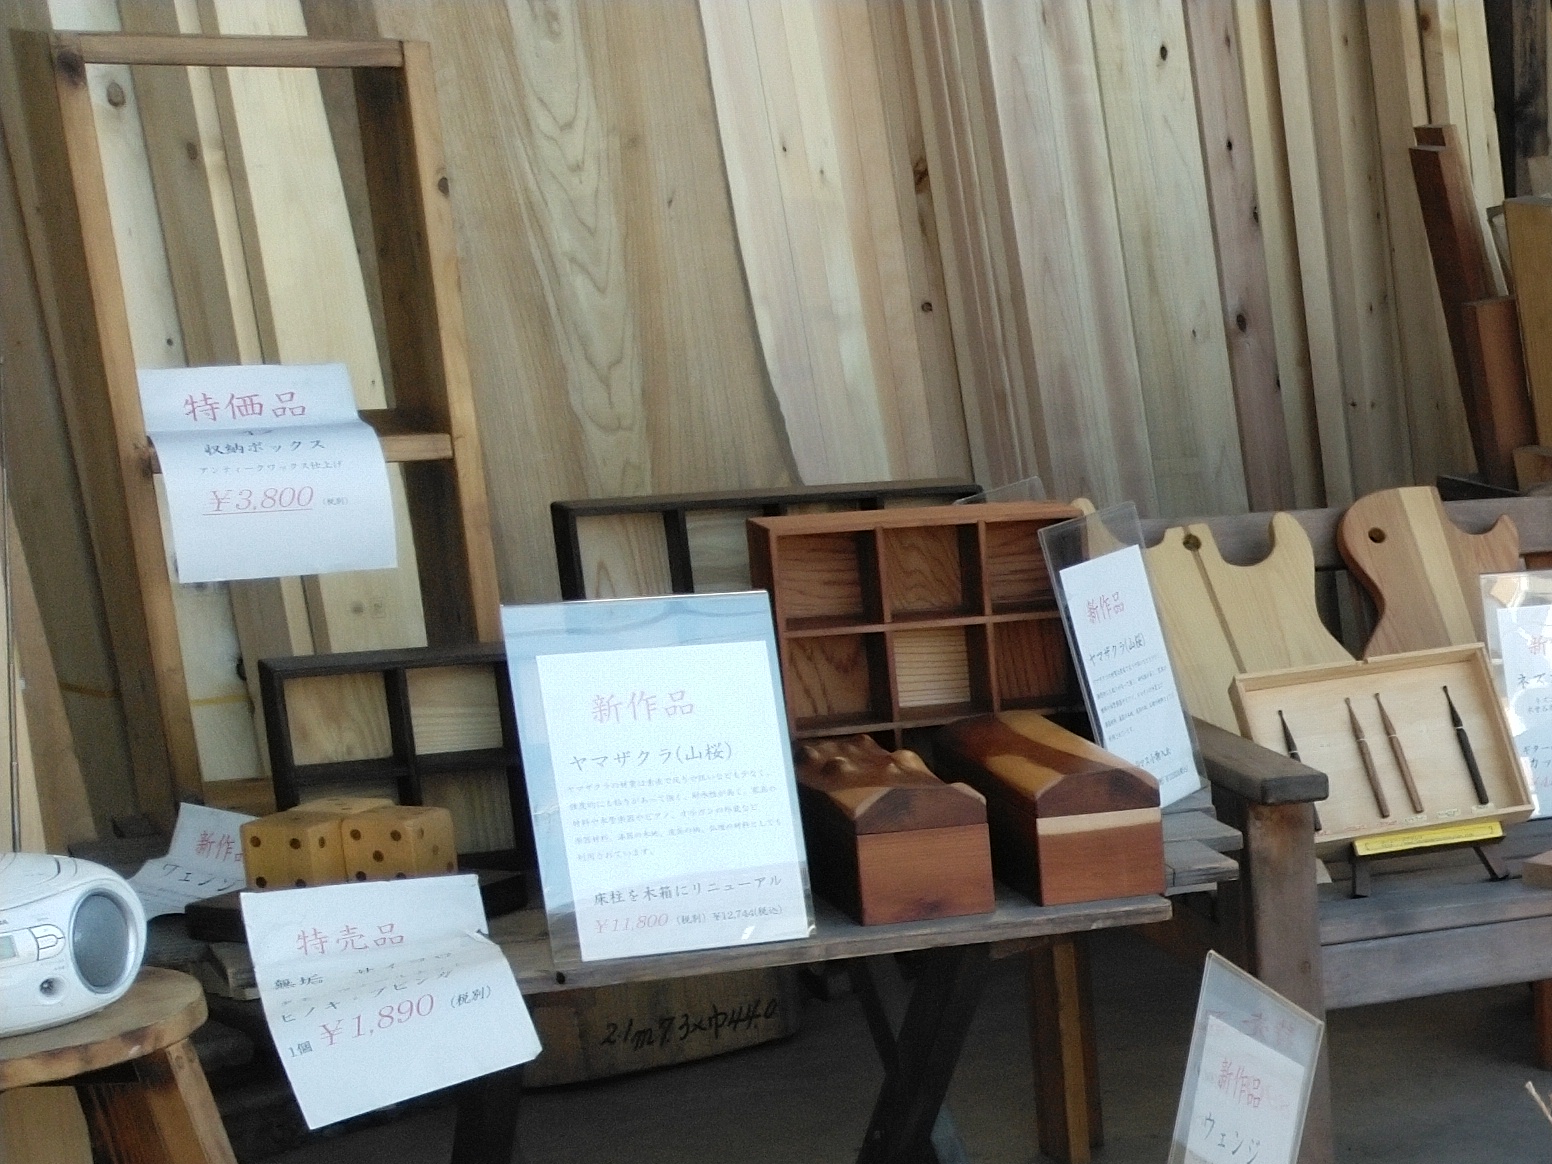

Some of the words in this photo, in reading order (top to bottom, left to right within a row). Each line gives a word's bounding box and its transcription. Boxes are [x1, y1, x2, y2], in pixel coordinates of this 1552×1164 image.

[184, 391, 306, 421] 特価品
[204, 438, 326, 455] 収納ボックス
[209, 486, 313, 512] ¥3,800
[591, 689, 695, 725] 新作品
[570, 741, 732, 772] ヤマザクラ(山桜)
[594, 875, 782, 907] 床柱を木箱にリニューアル
[297, 922, 405, 957] 特売品
[319, 993, 435, 1046] ¥1,890
[1218, 1057, 1263, 1109] 新作品
